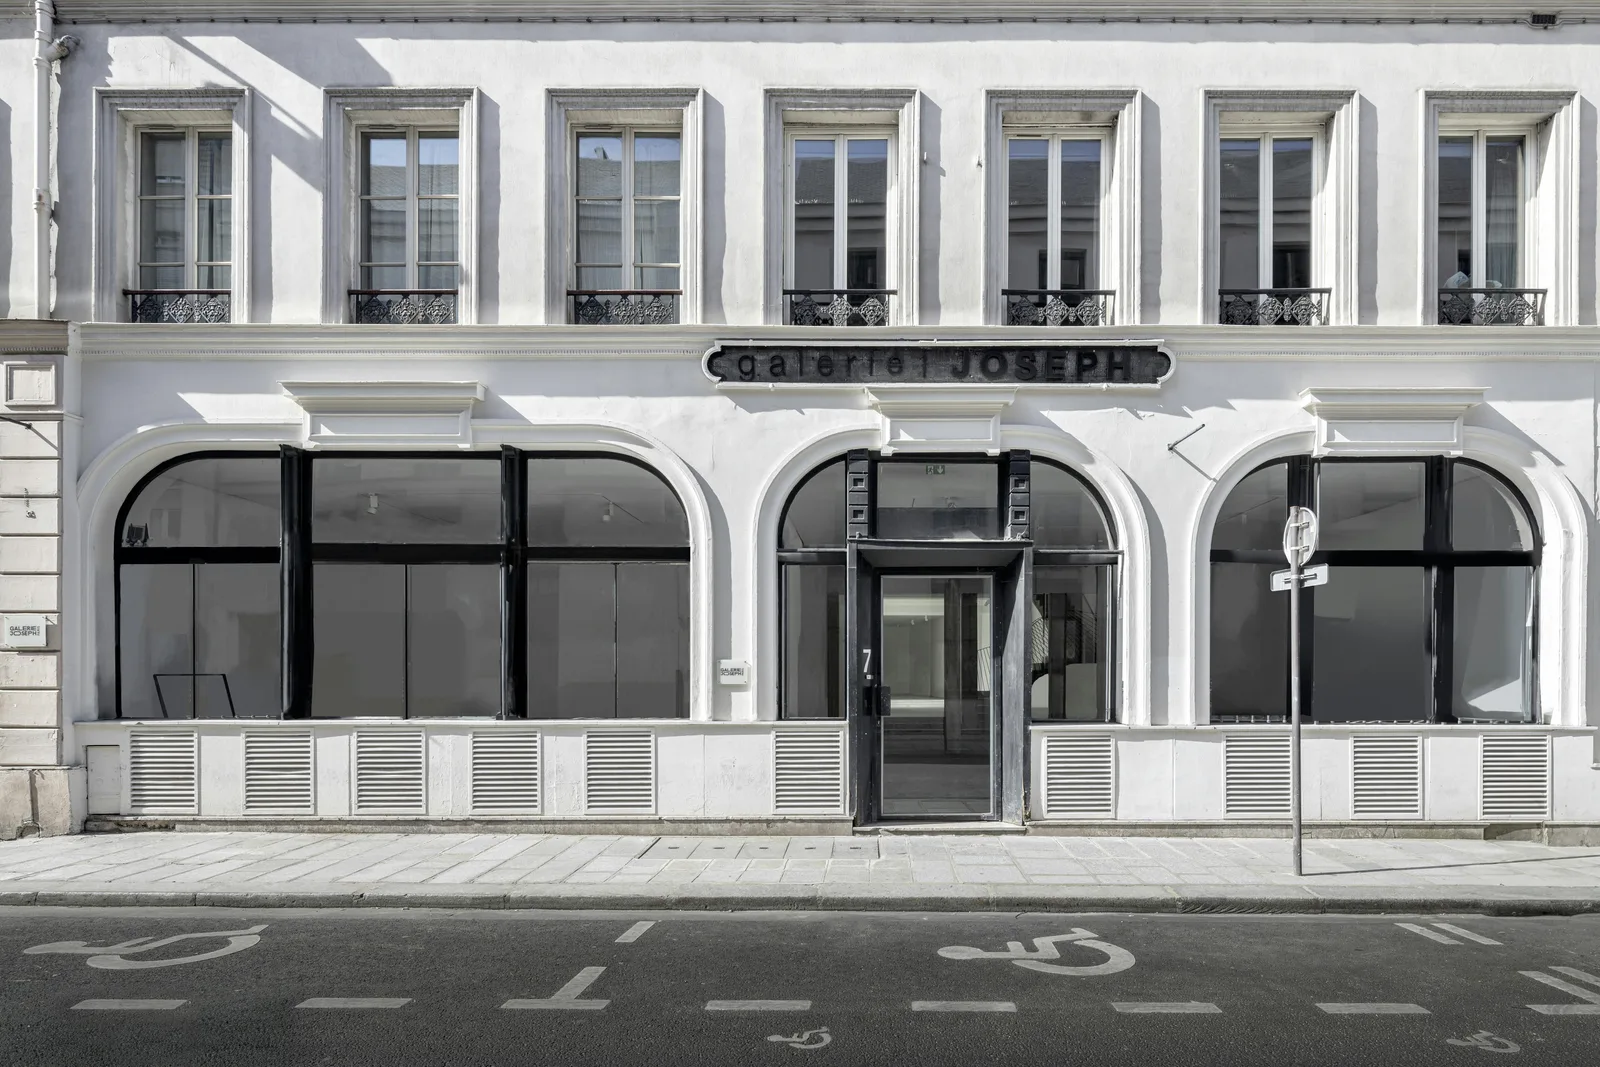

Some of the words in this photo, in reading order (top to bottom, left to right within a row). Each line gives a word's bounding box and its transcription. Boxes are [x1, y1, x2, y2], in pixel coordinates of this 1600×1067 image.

[738, 350, 904, 382] galerie
[953, 350, 1132, 382] JOSEPH
[863, 649, 871, 672] 7
